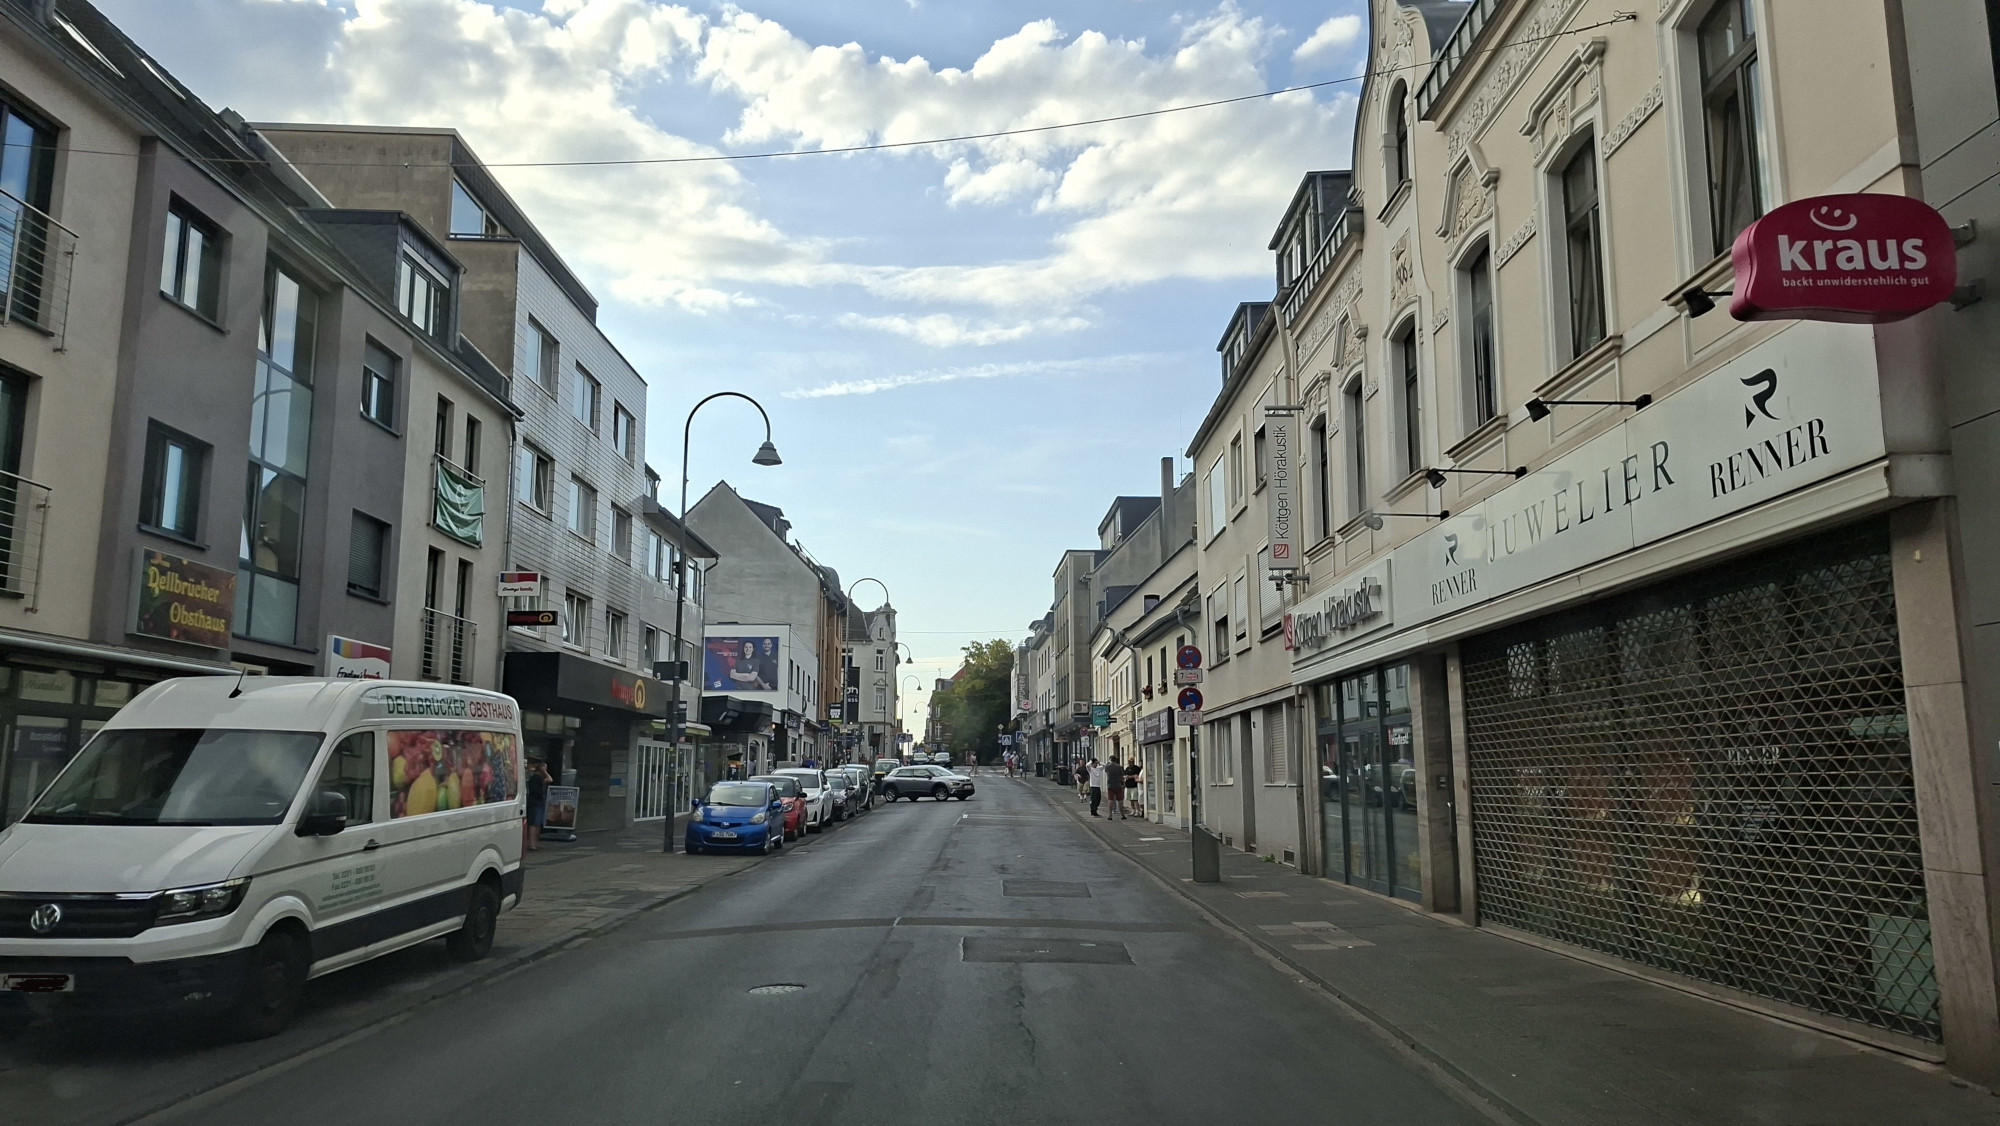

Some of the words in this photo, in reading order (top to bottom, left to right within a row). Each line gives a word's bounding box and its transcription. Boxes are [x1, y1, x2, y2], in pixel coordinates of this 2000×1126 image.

[1777, 234, 1927, 271] kraus
[1782, 277, 1813, 287] backt
[1817, 275, 1907, 287] unwiderstehlich
[1910, 276, 1930, 287] gut
[1273, 425, 1287, 489] Hörakustik
[1709, 418, 1832, 500] RENNER
[1275, 493, 1292, 540] Köttgen
[1488, 440, 1676, 563] JUWELIER
[148, 566, 220, 602] Dellbrücker
[1431, 568, 1478, 606] RENNER
[169, 602, 226, 632] Obsthaus
[386, 694, 467, 717] DELLBRÜCKER
[469, 701, 513, 720] OBSTHAUS
